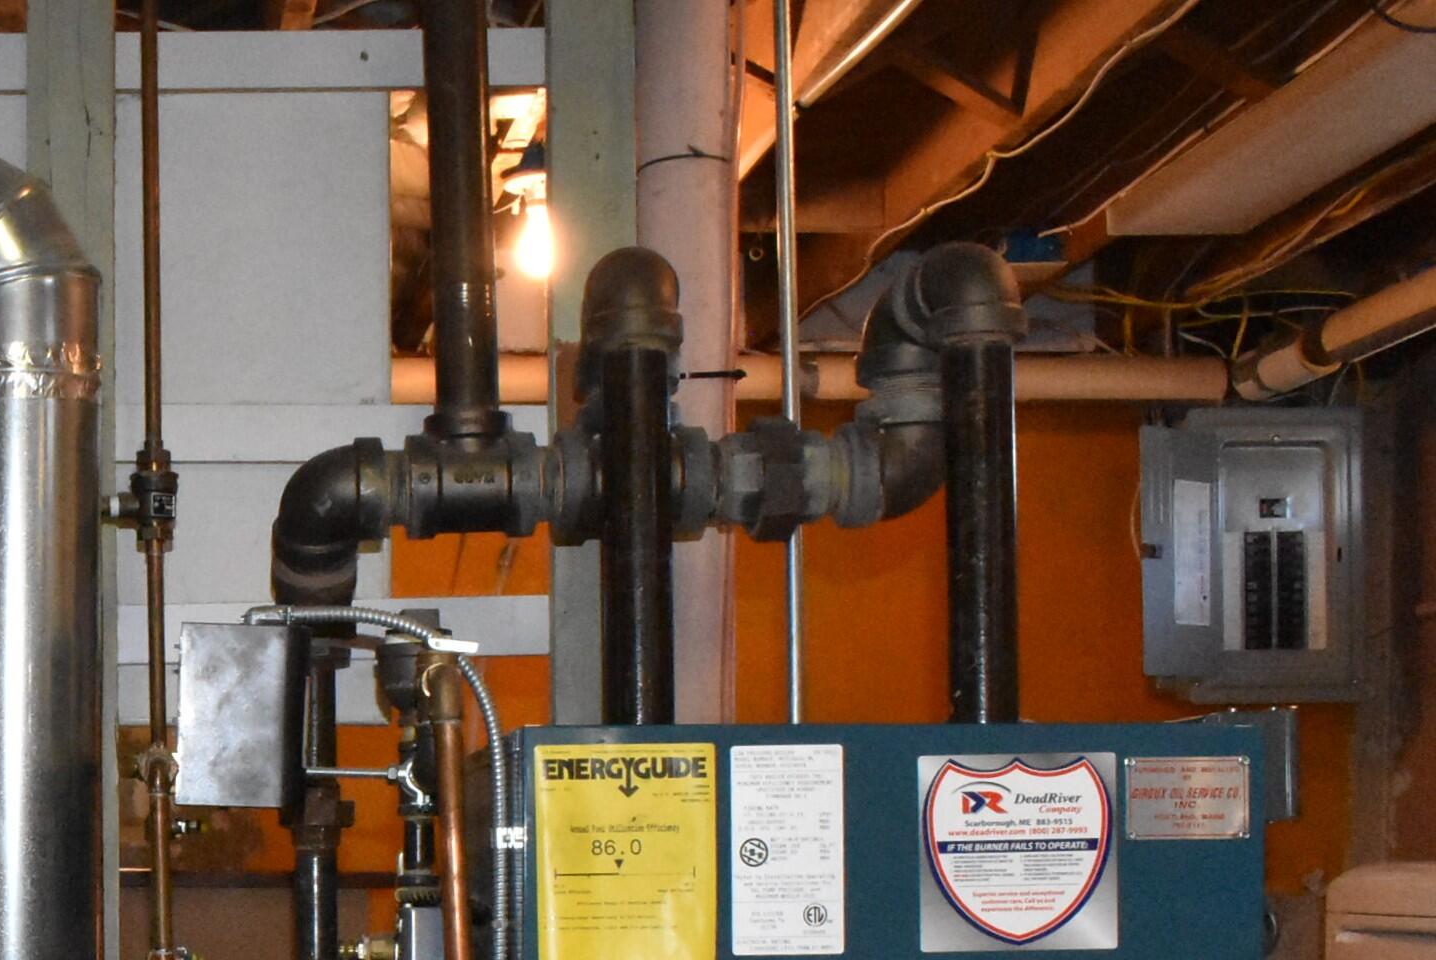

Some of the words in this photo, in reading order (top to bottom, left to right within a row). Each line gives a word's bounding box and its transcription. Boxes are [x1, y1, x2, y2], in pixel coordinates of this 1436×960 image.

[544, 756, 708, 781] ENERGYGUIDE
[1186, 786, 1224, 799] SERVICE
[1038, 804, 1083, 815] Company
[1018, 818, 1031, 826] ME
[1028, 826, 1050, 836] (800)
[591, 838, 642, 856] 86.0
[947, 843, 956, 852] IF
[957, 843, 974, 852] THE
[974, 842, 1010, 852] BURNER
[1010, 841, 1034, 851] FAILS
[1034, 841, 1047, 850] TO
[1047, 839, 1089, 850] OPERATE:
